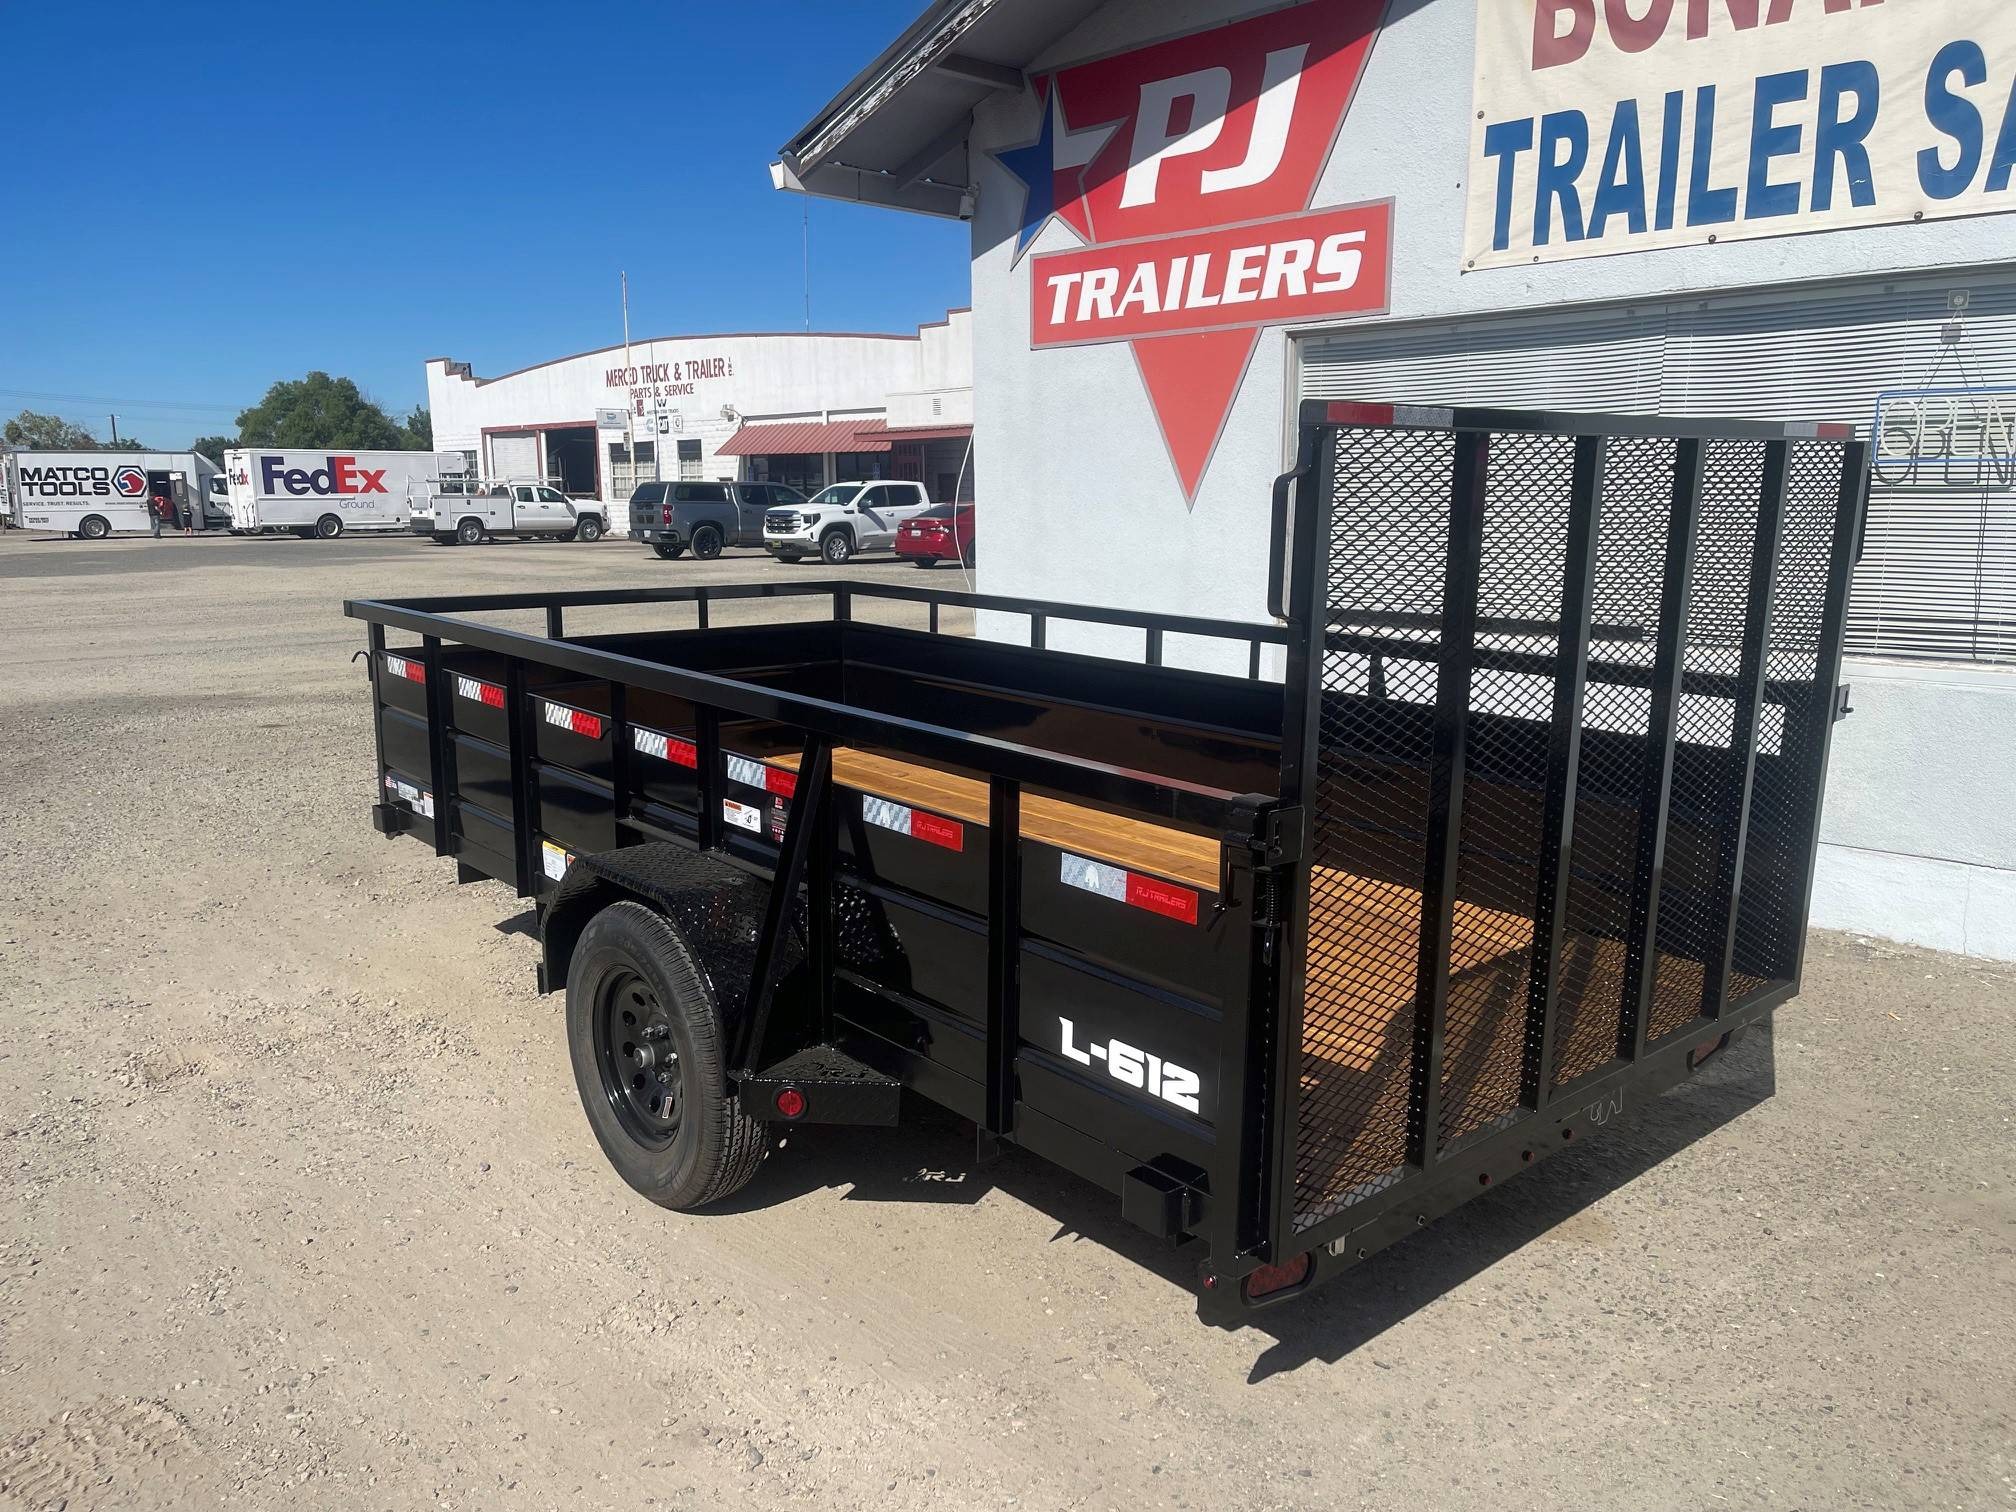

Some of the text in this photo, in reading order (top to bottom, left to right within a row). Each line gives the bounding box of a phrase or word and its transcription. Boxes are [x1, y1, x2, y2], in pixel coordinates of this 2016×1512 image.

[1118, 42, 1311, 209] PJ
[1483, 60, 1880, 252] TRAILER
[1046, 229, 1367, 326] TRAILERS
[641, 363, 669, 384] TRUCK
[674, 362, 682, 380] &
[685, 357, 725, 380] TRAILER
[630, 382, 694, 400] PARTS & SERVICE
[19, 467, 110, 482] MATCO
[21, 481, 111, 496] TOOLS
[260, 456, 389, 496] FedEx
[339, 499, 375, 509] Ground
[1058, 1016, 1200, 1115] L-612
